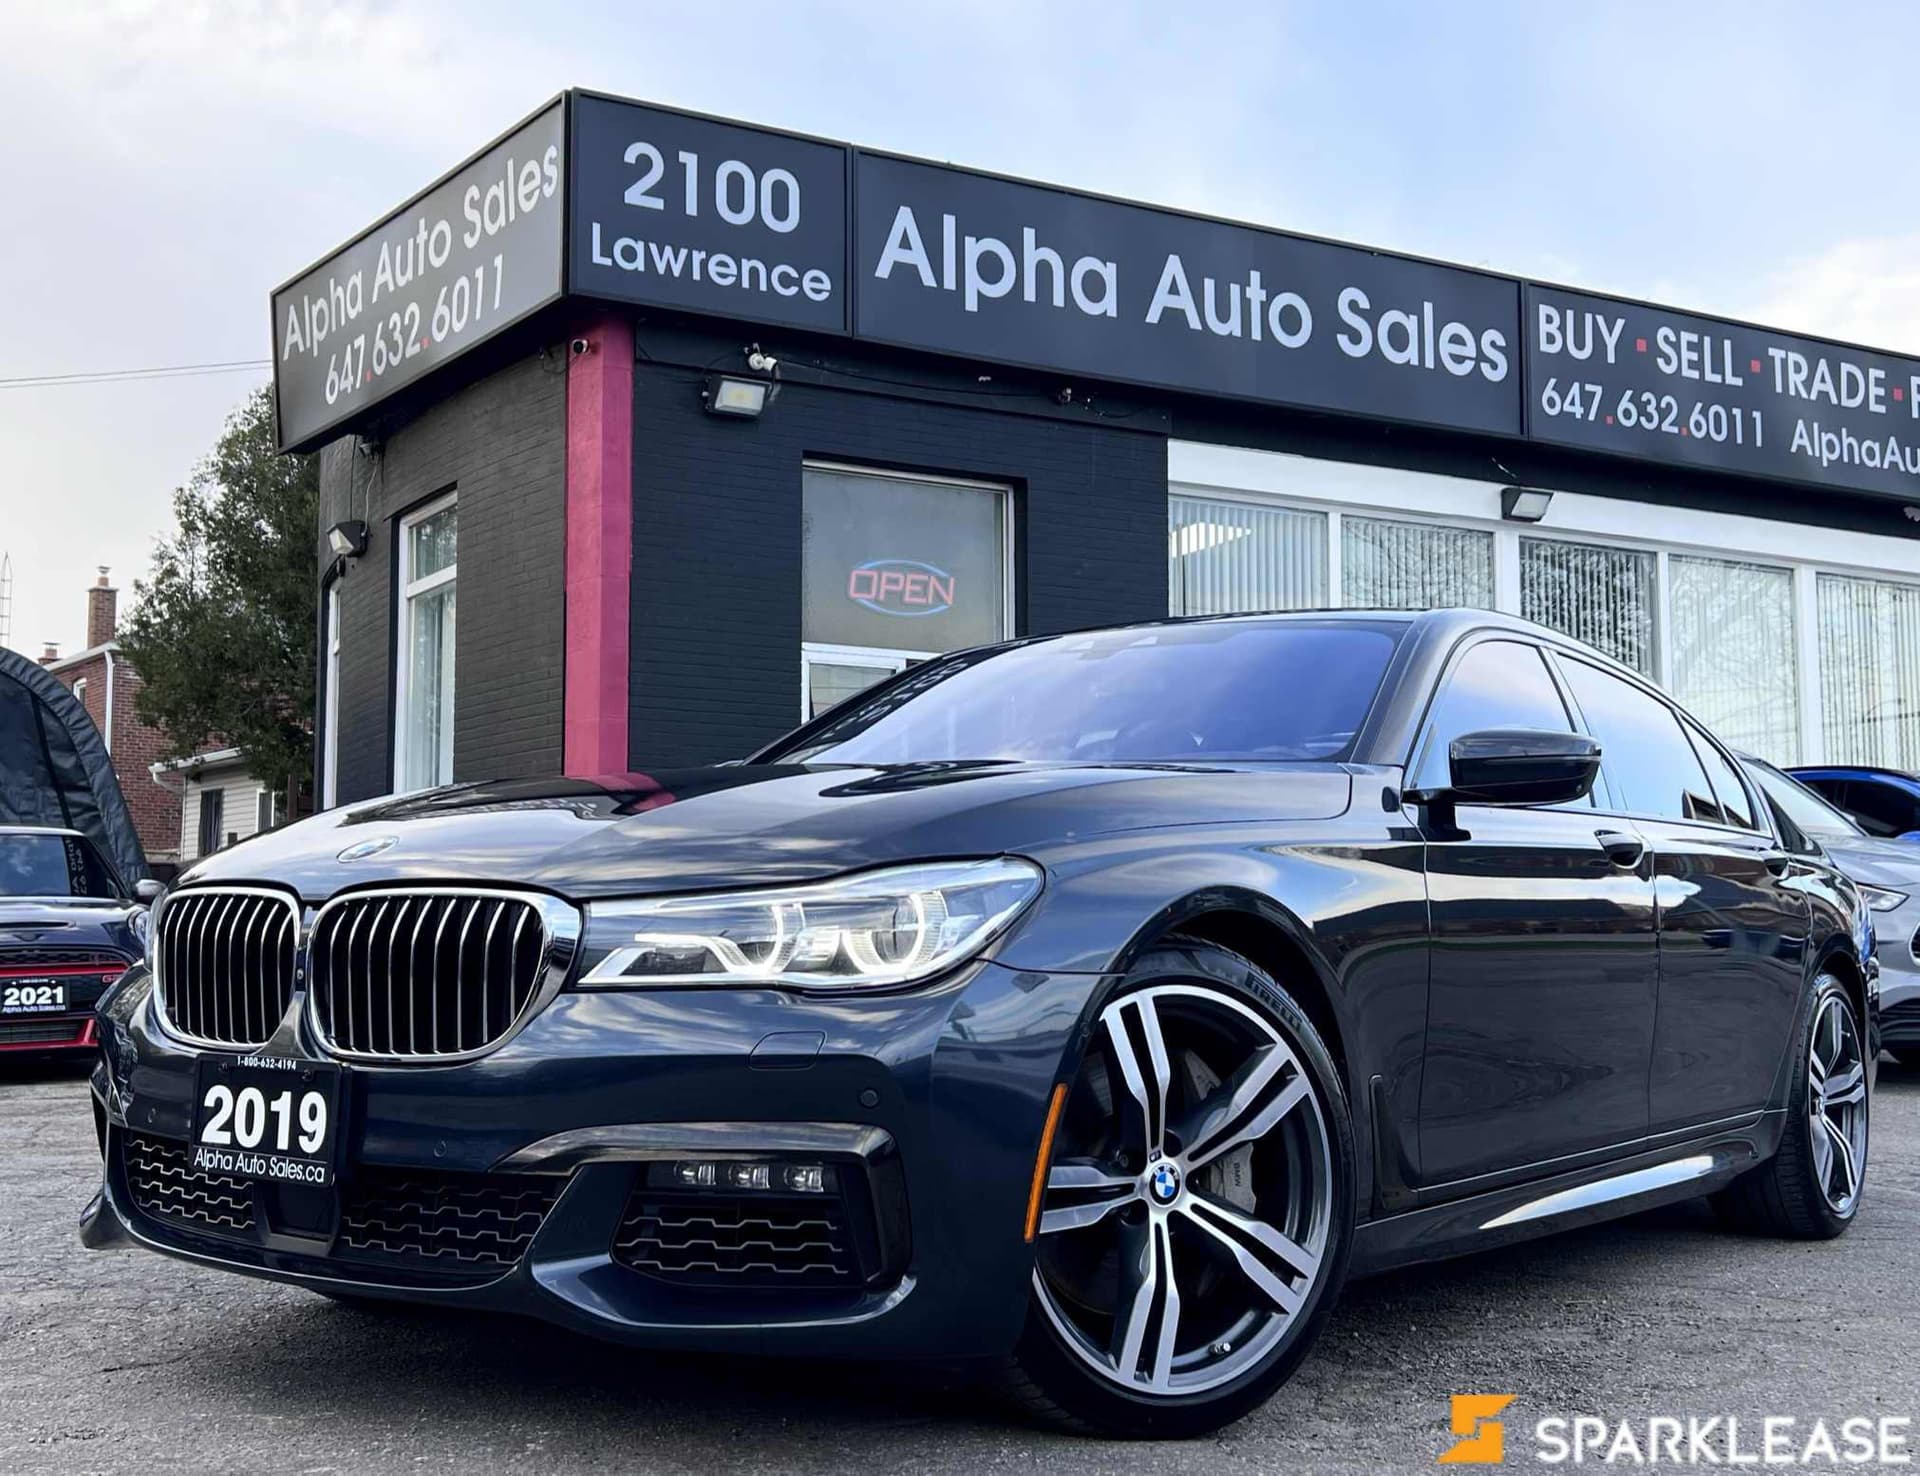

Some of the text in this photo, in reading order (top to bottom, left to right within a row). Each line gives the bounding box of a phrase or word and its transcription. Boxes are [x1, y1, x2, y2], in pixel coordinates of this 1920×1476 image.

[623, 141, 800, 233] 2100
[282, 144, 559, 362] Alpha Auto Sales
[591, 221, 832, 302] Lawrence
[875, 205, 1508, 382] Alpha Auto Sales
[325, 253, 504, 405] 647.632.6011
[1538, 303, 1626, 365] BUY
[1656, 326, 1743, 387] SELL
[1767, 346, 1887, 414] TRADE
[1541, 377, 1764, 448] 647.632.6011
[848, 569, 955, 606] OPEN
[4, 986, 64, 1005] 2021
[201, 1084, 327, 1154] 2019
[194, 1148, 325, 1183] Alpha Auto Sales.ca
